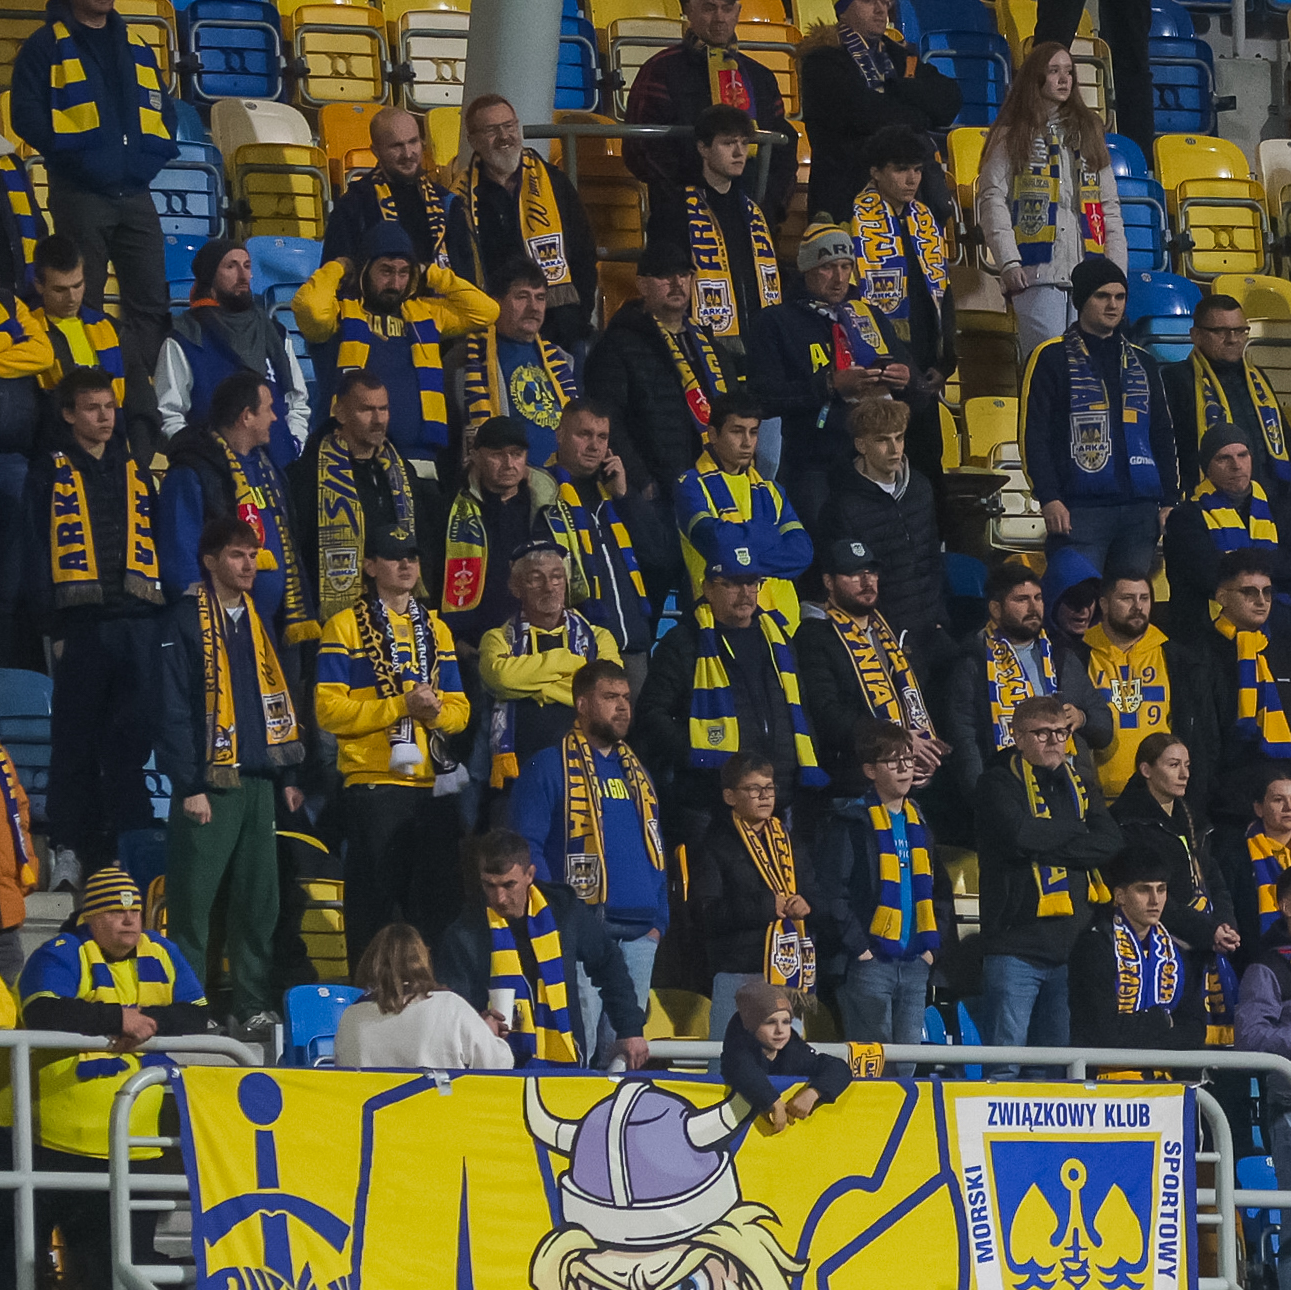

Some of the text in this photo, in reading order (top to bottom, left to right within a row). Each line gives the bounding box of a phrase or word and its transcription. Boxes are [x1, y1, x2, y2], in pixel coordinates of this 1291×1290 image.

[857, 190, 895, 266] TYLKO
[1076, 442, 1108, 454] ARKA
[1141, 666, 1157, 684] 9
[1146, 705, 1162, 726] 9
[987, 1102, 1151, 1132] ZWIĄZKOWY KLUB
[964, 1165, 994, 1264] MORSKI
[1157, 1140, 1182, 1279] SPORTOWY
